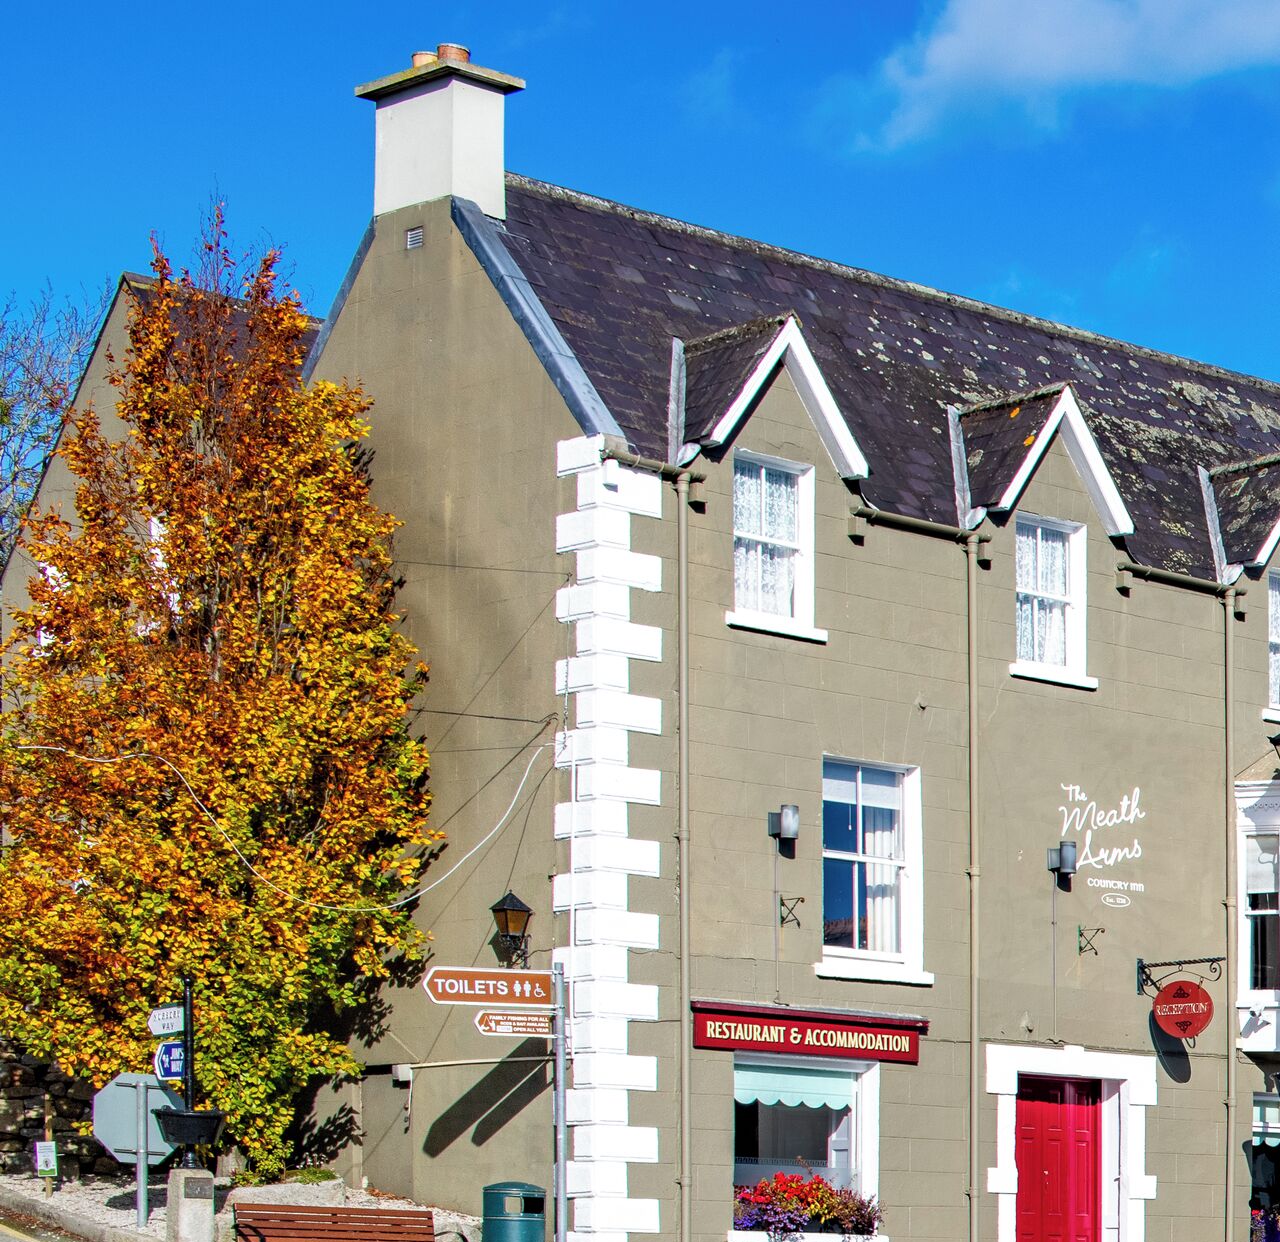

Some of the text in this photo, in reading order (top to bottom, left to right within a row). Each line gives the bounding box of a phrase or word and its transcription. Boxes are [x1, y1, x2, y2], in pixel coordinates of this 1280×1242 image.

[1061, 783, 1088, 801] The
[1059, 787, 1146, 836] Meath
[1072, 830, 1142, 873] Arms
[433, 978, 509, 995] TOILETS
[1156, 1002, 1208, 1016] RECEPTION
[706, 1021, 910, 1053] RESTAURANT & ACCOMMODATION
